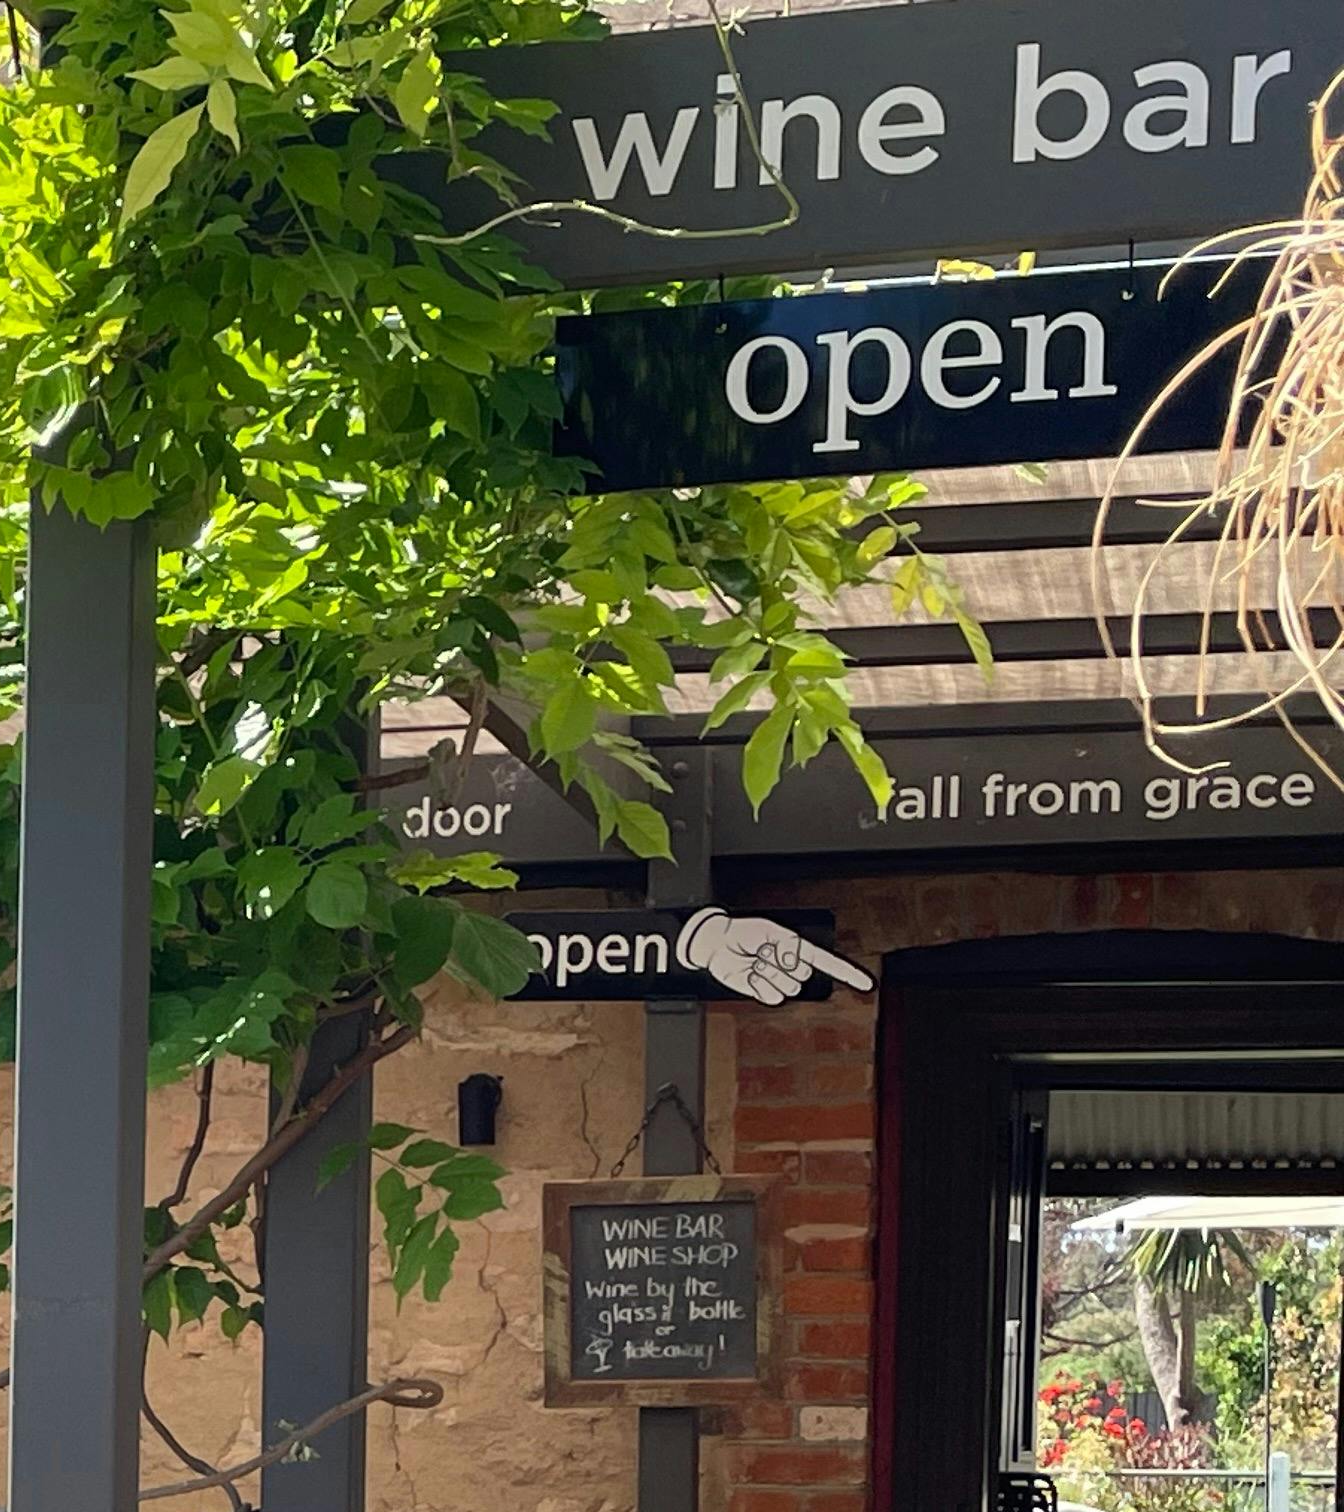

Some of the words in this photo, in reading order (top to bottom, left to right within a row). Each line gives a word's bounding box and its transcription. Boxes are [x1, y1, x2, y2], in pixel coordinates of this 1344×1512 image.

[572, 74, 945, 201] wine
[1012, 43, 1291, 164] bar
[726, 311, 1118, 454] open
[982, 773, 1122, 818] from
[1143, 770, 1316, 822] grace
[402, 796, 513, 839] door
[602, 1218, 669, 1242] WINE
[675, 1213, 725, 1240] BAR
[605, 1245, 667, 1270] WINE
[671, 1242, 739, 1268] SHOP
[646, 1276, 675, 1308] by
[598, 1302, 658, 1336] glass
[688, 1299, 747, 1322] bottle
[654, 1324, 677, 1337] or
